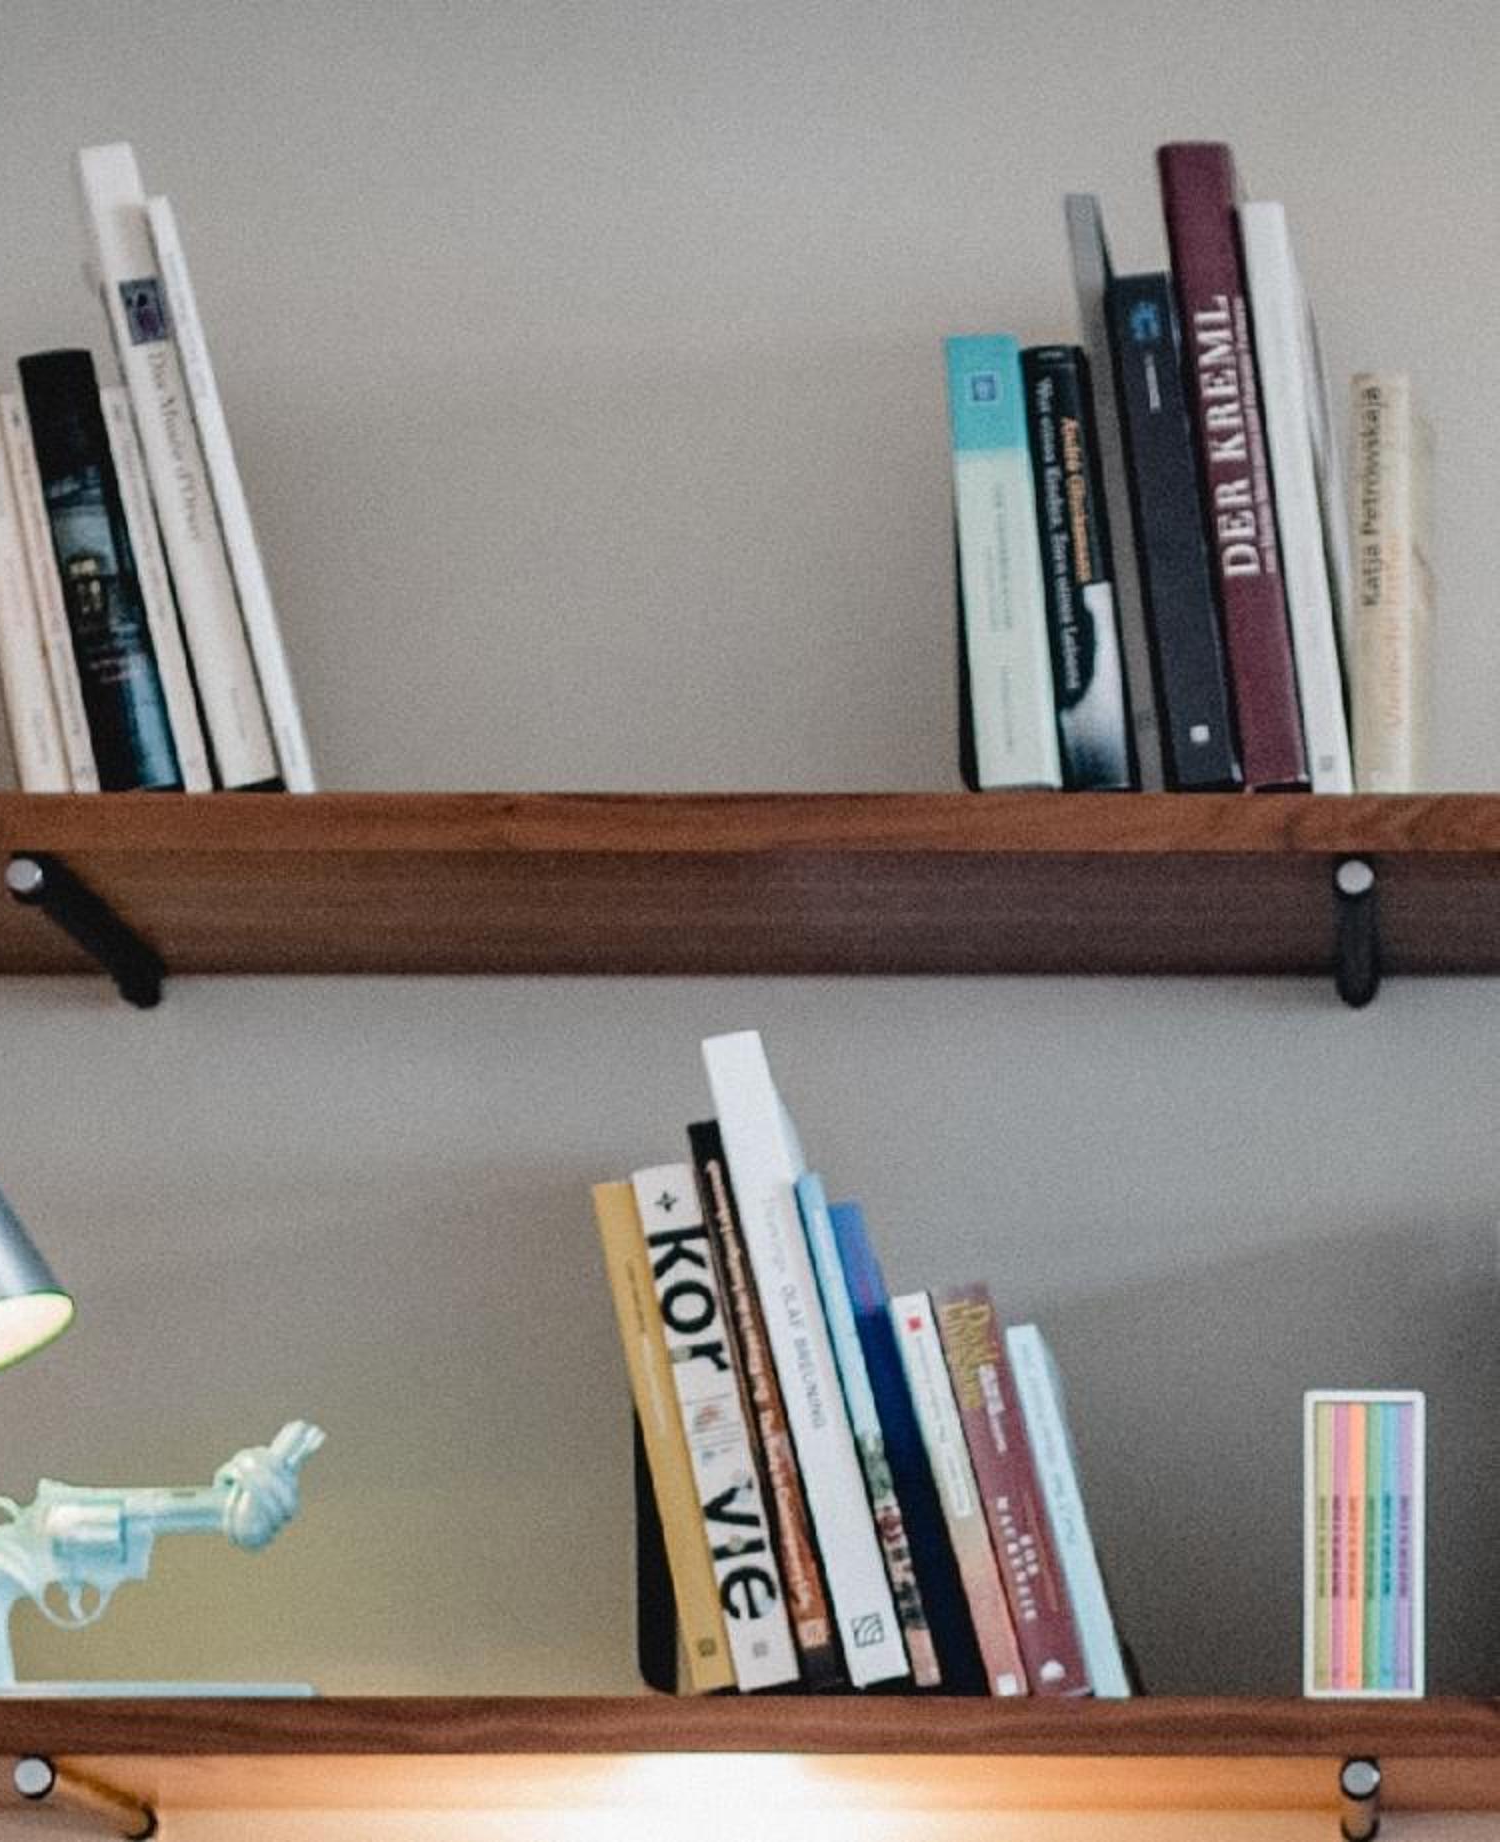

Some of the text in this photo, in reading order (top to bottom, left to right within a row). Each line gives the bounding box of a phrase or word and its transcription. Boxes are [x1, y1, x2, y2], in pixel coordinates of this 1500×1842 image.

[1193, 294, 1248, 463] KREML
[1214, 478, 1261, 577] DER
[1360, 386, 1382, 606] Katja Petrowskaja
[647, 1223, 730, 1374] kor
[703, 1480, 778, 1621] vie
